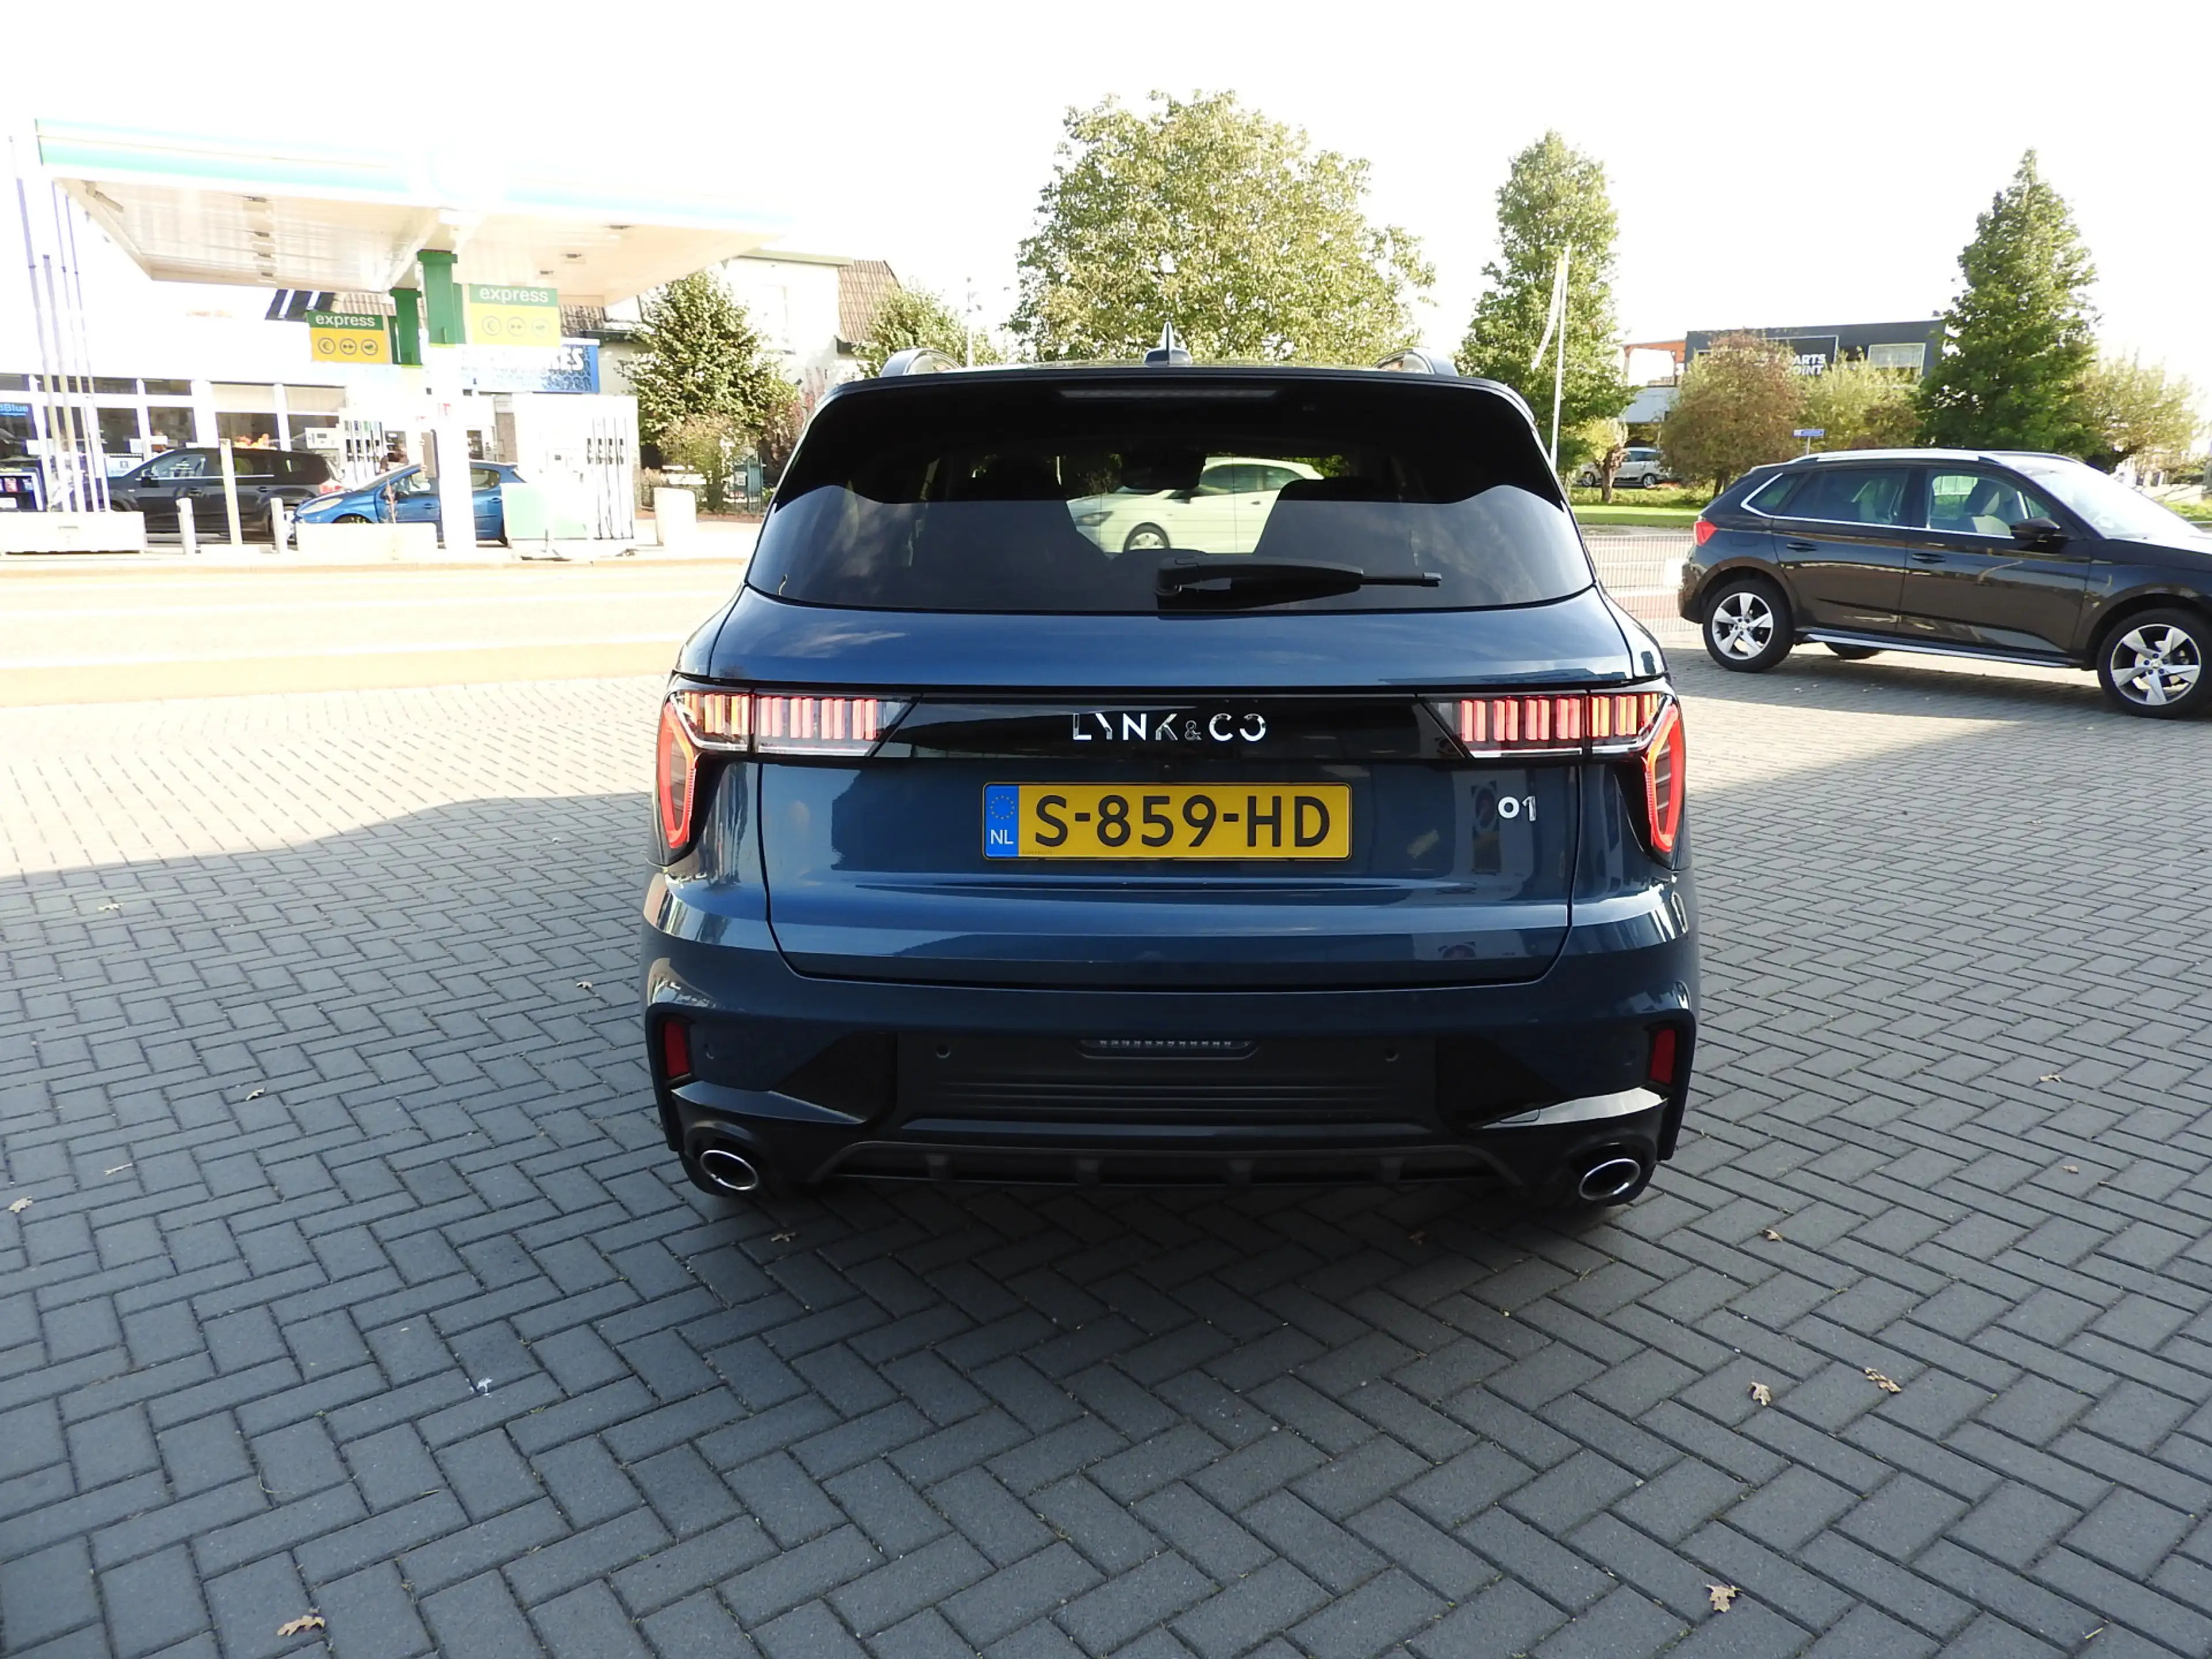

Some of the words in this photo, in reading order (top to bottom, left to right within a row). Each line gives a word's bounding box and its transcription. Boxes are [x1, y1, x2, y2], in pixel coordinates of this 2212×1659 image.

[479, 287, 549, 304] express
[315, 315, 376, 328] express
[1035, 795, 1330, 847] S-859-HD
[990, 829, 1014, 844] NL
